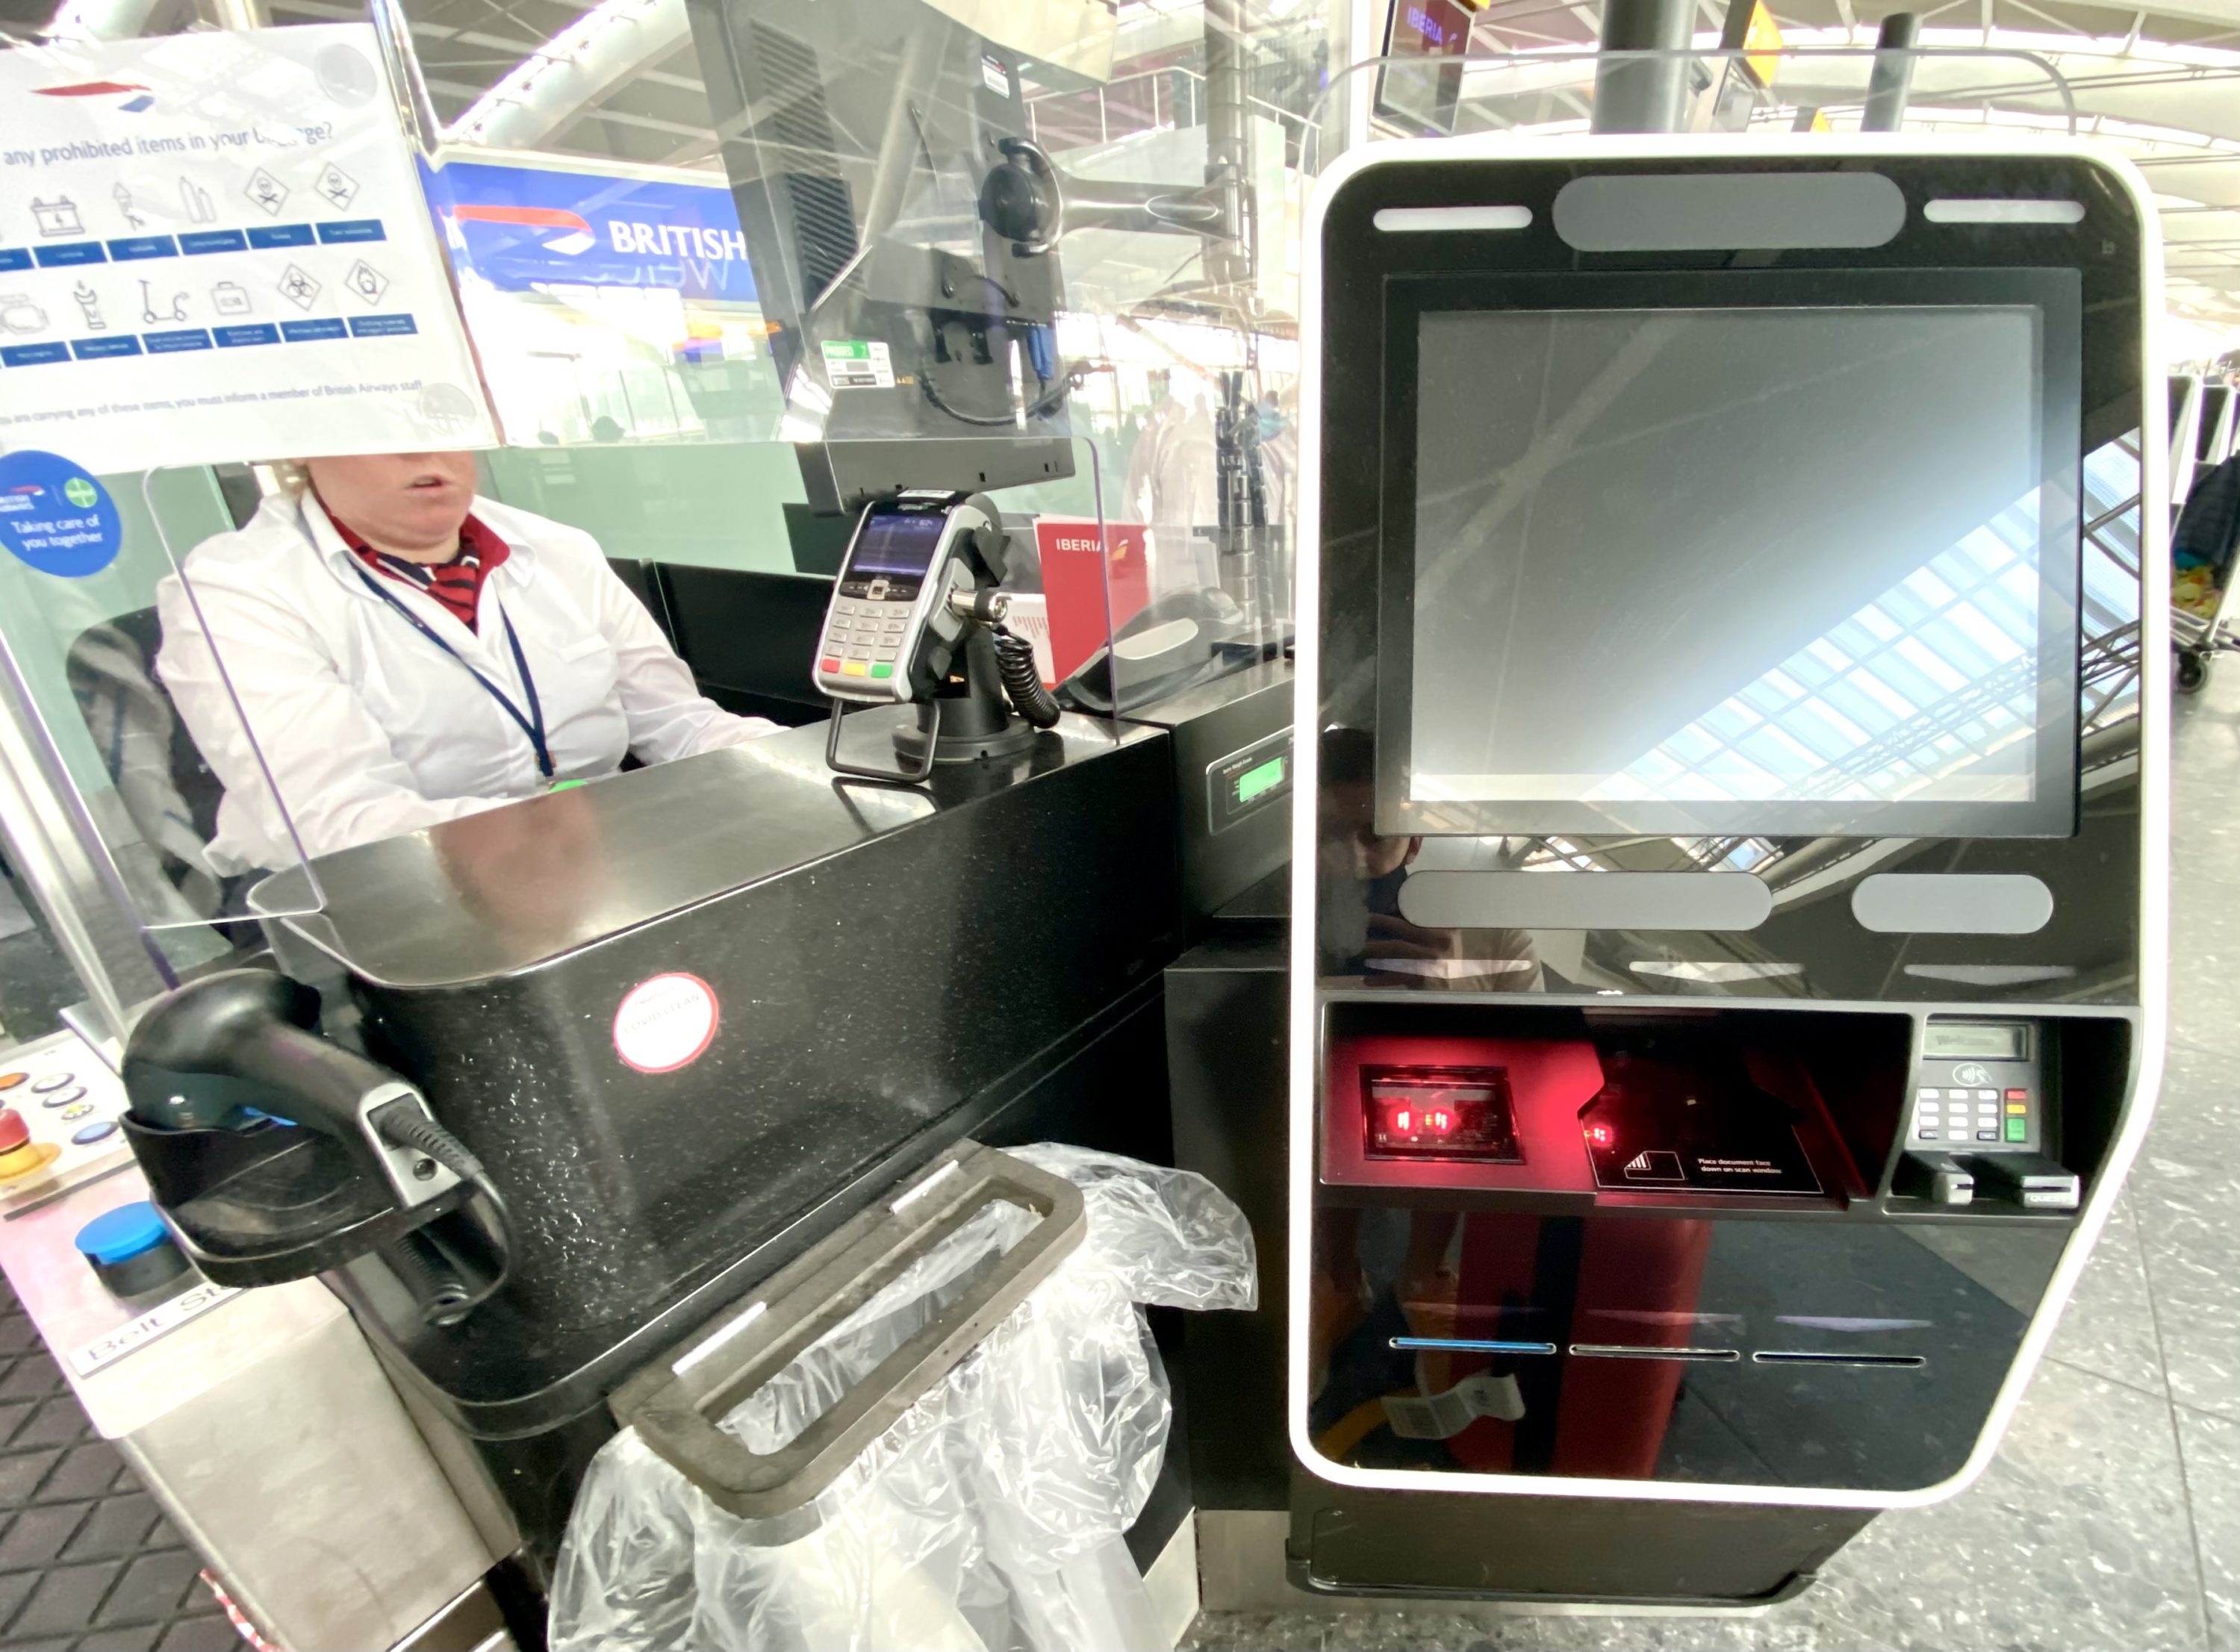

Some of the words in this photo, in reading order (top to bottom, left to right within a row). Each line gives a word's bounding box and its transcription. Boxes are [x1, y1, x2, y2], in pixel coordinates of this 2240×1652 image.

[1407, 6, 1443, 46] IBERIA
[4, 150, 35, 167] any
[40, 137, 134, 166] prohibited
[135, 131, 186, 155] items
[188, 131, 206, 150] in
[210, 131, 249, 152] your
[609, 220, 747, 261] BRITISH
[260, 393, 267, 401] a
[268, 387, 309, 400] member
[311, 385, 323, 397] of
[324, 384, 357, 396] British
[359, 382, 399, 394] Airways
[399, 379, 423, 391] staff
[10, 520, 57, 534] Taking
[56, 519, 84, 530] care
[86, 514, 100, 527] of
[22, 538, 48, 552] you
[49, 531, 103, 549] together
[87, 1318, 164, 1361] Belt
